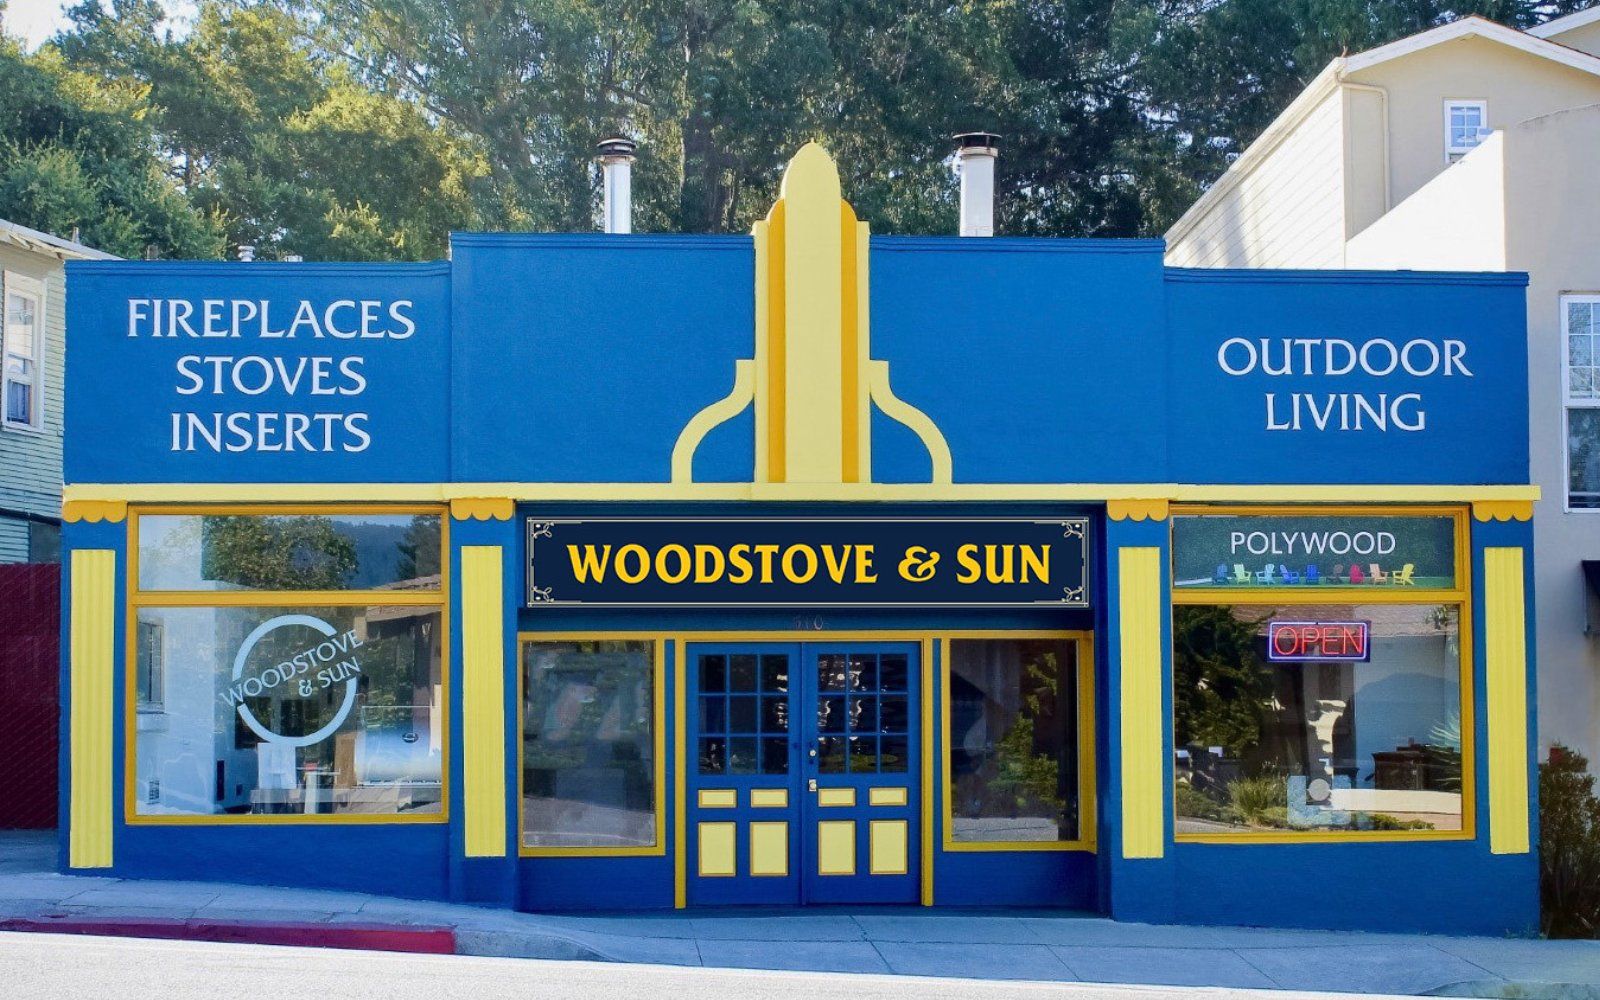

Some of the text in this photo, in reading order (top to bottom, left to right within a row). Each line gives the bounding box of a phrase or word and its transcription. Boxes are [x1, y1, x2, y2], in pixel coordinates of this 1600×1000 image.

[128, 299, 416, 340] FIREPLACES
[176, 355, 367, 396] STOVES
[1217, 337, 1474, 377] OUTDOOR
[171, 412, 371, 453] INSERTS
[1265, 393, 1426, 432] LIVING
[1230, 531, 1396, 555] POLYWOOD
[566, 543, 1052, 585] WOODSTOVE & SUN
[1274, 626, 1363, 655] OPEN
[219, 629, 364, 707] WOODSTOVE
[298, 656, 361, 697] & SUN
